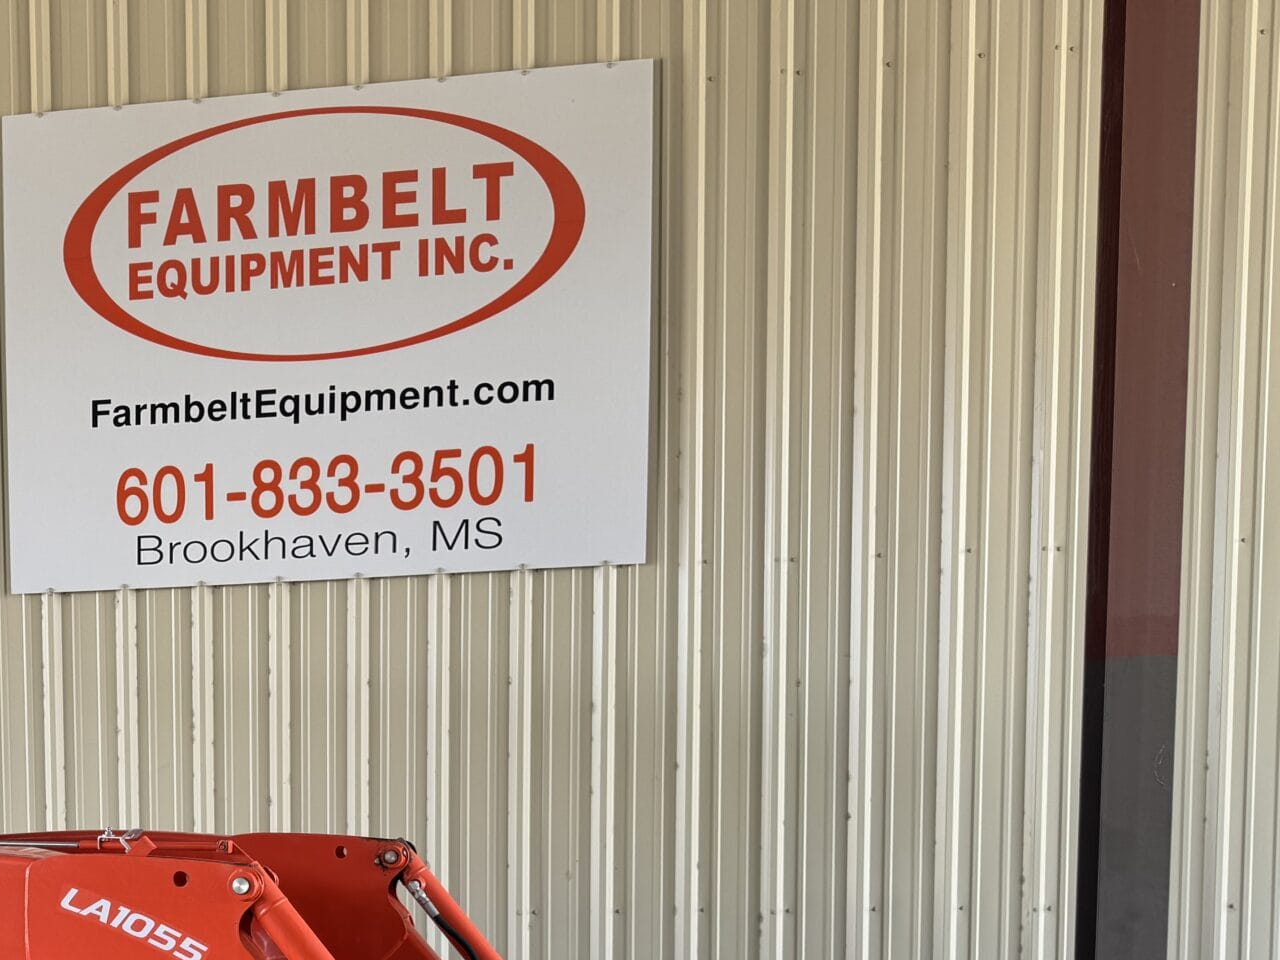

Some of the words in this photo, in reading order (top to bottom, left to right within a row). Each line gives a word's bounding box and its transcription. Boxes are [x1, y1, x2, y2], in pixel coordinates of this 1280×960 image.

[127, 162, 514, 248] FARMBELT
[129, 242, 400, 301] EQUIPMENT
[419, 234, 513, 277] INC.
[92, 379, 554, 428] FarmbeltEquipment.com
[116, 444, 534, 526] 601-833-3501
[136, 530, 410, 565] Brookhaven,
[431, 517, 504, 551] MS
